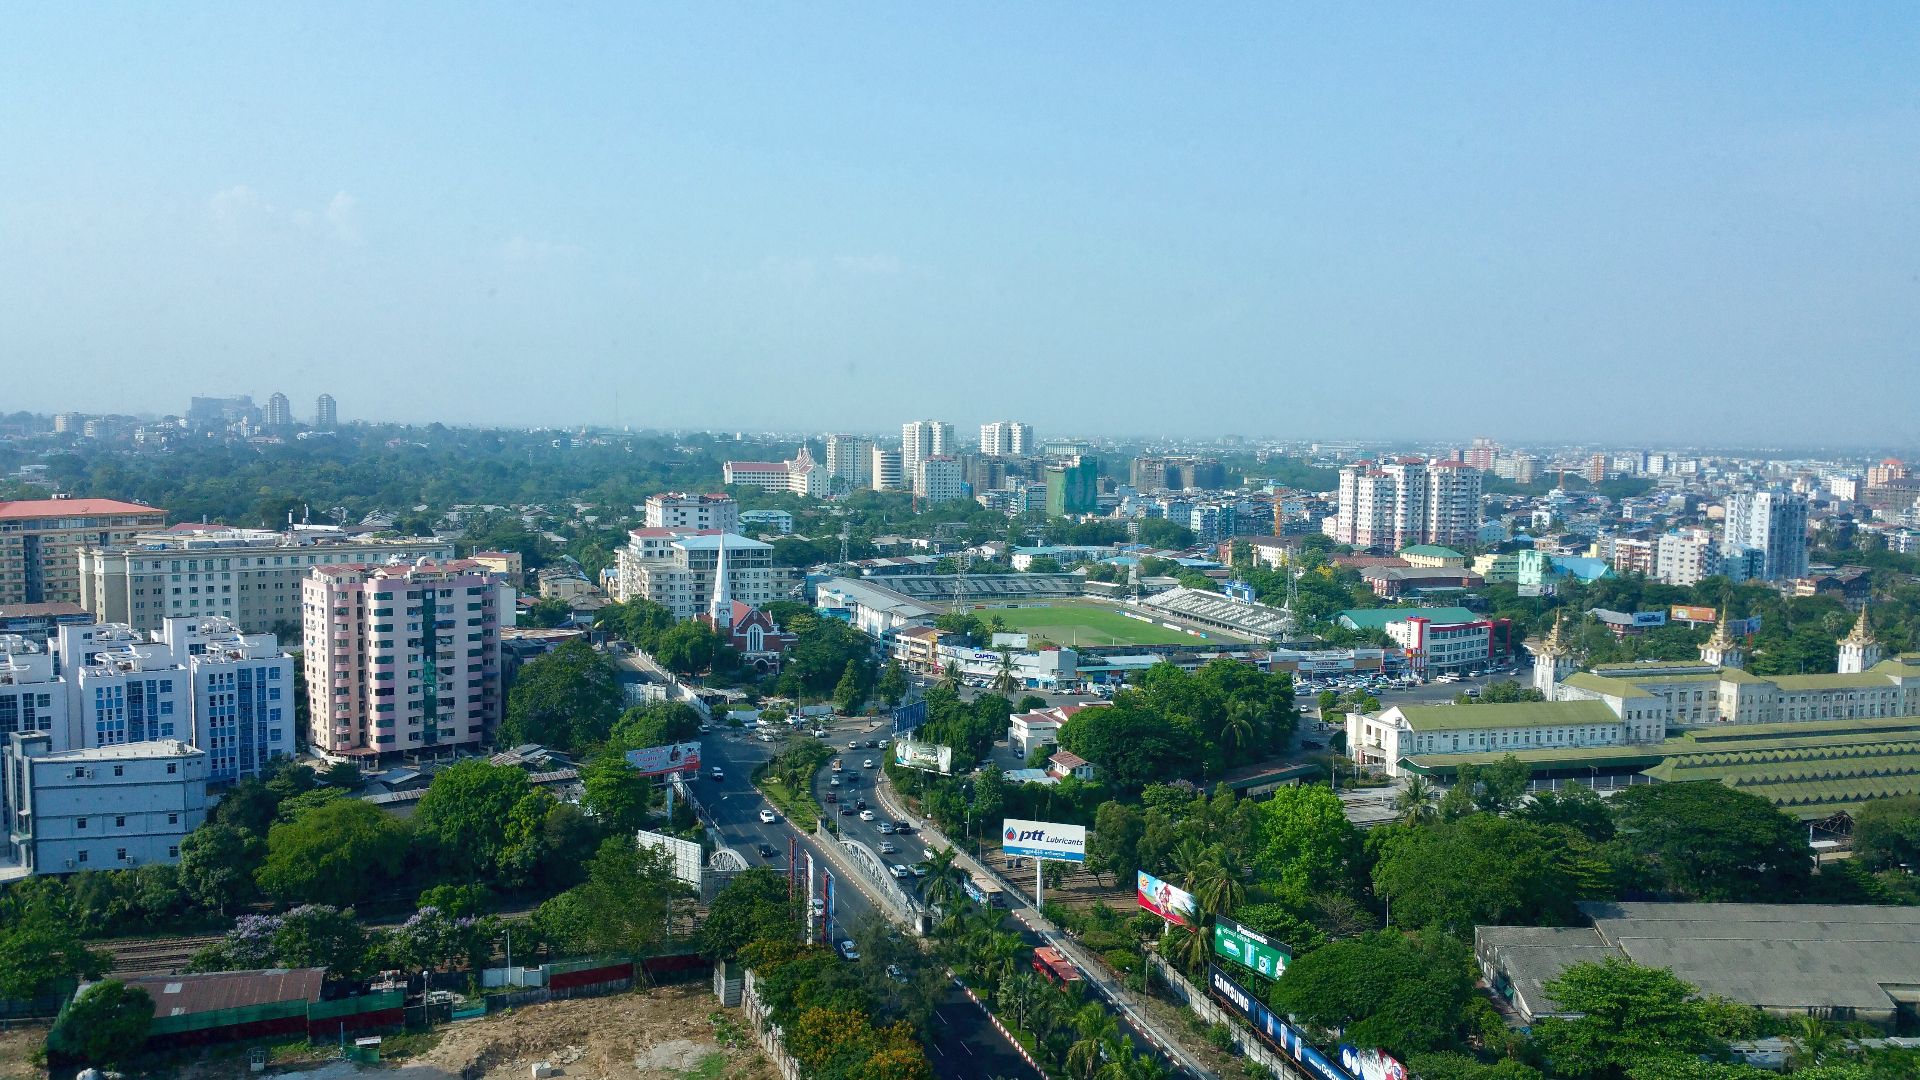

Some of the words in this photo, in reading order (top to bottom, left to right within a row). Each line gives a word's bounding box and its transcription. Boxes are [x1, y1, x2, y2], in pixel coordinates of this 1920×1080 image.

[1018, 830, 1045, 842] ptt
[1046, 836, 1083, 846] Lubricants
[1236, 924, 1268, 945] Panasonic
[1214, 974, 1249, 1012] SAMSUNG
